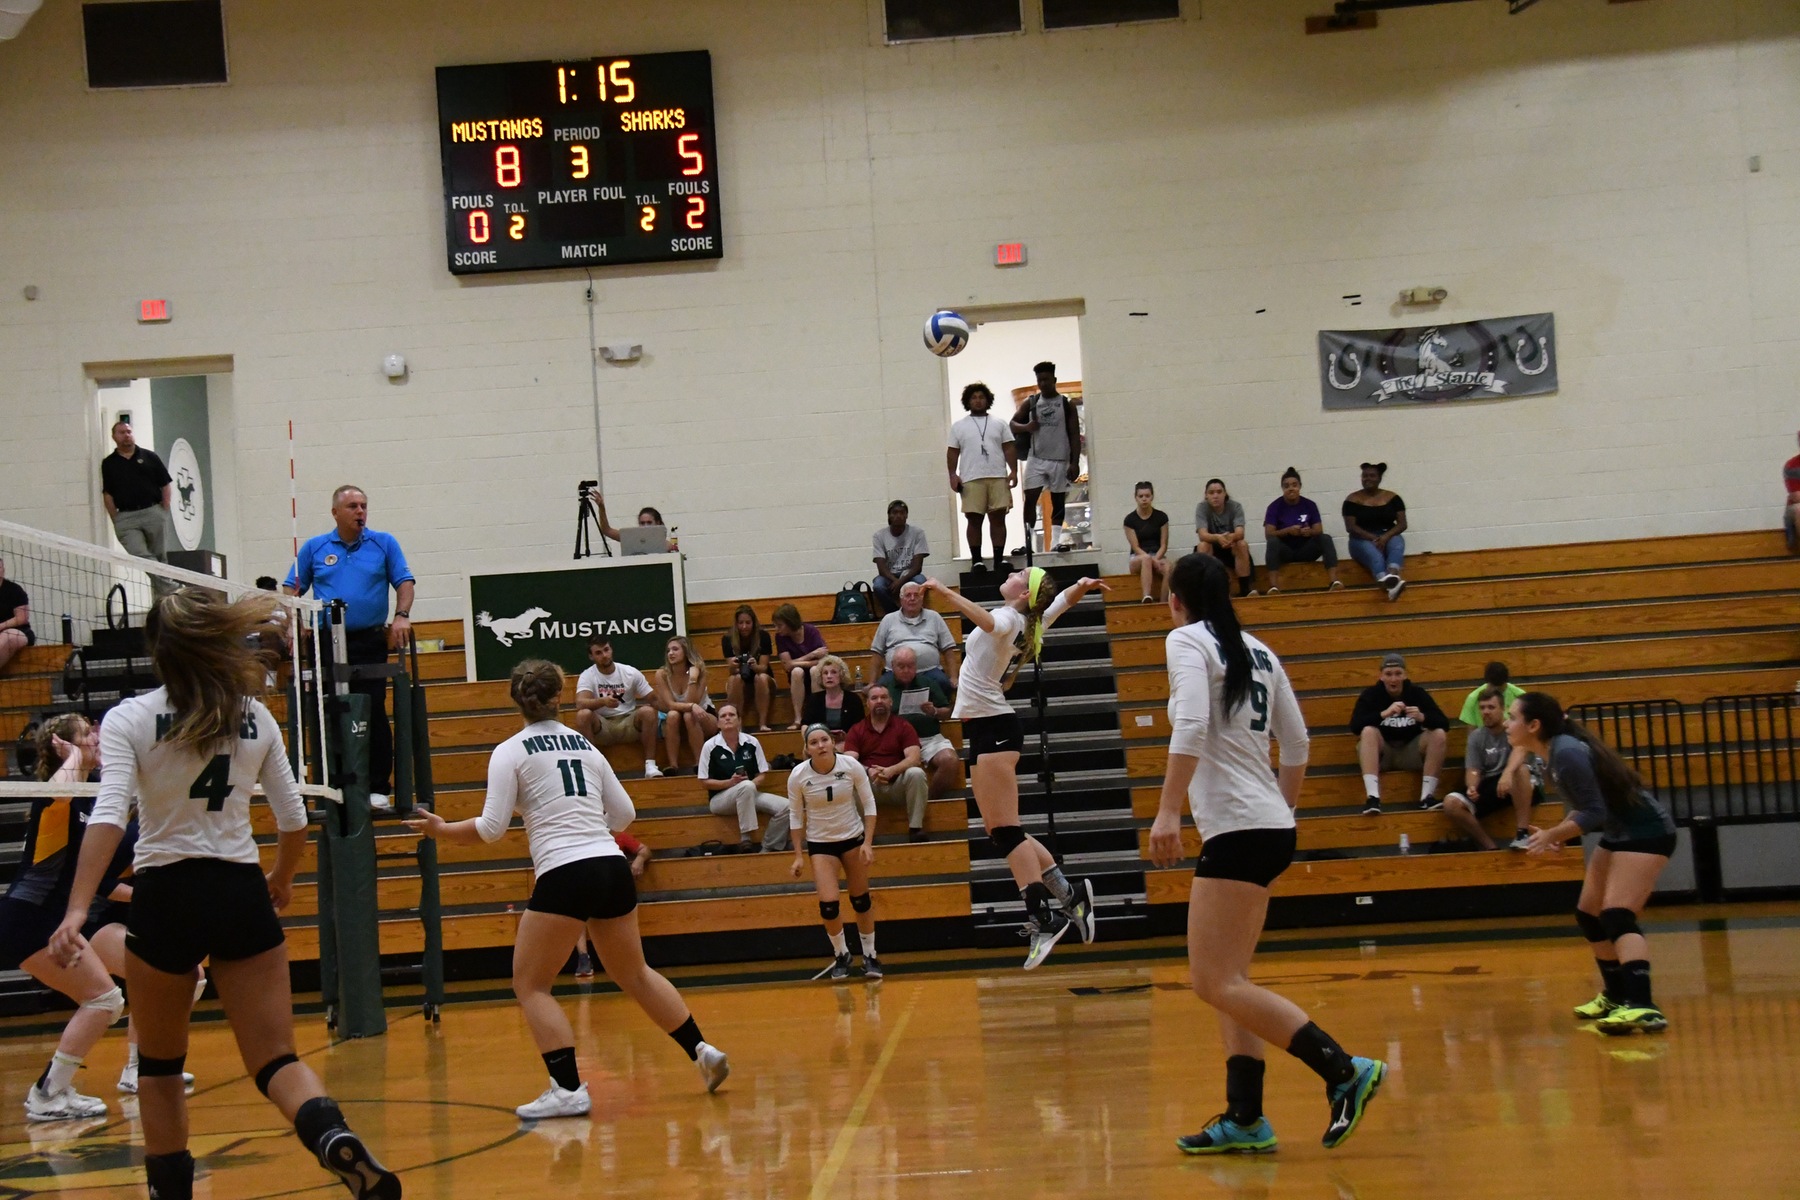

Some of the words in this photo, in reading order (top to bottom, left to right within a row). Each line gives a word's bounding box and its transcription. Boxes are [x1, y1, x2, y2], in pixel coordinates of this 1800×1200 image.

[452, 117, 543, 143] MUSTANGS
[620, 108, 685, 132] SHARKS
[554, 126, 600, 141] PERIOD
[570, 145, 589, 179] 3
[678, 133, 703, 176] 5
[495, 146, 521, 187] 8
[538, 188, 588, 204] PLAYER
[593, 186, 627, 201] FOUL
[668, 180, 710, 196] FOULS
[452, 194, 494, 209] FOULS
[503, 203, 530, 213] T.O.L.
[635, 194, 661, 206] T.O.L.
[640, 206, 656, 231] 2
[686, 197, 705, 230] 2
[469, 211, 490, 243] 0
[509, 215, 525, 240] 2
[561, 243, 607, 259] MATCH
[671, 236, 713, 252] SCORE
[997, 243, 1023, 264] EXIT
[455, 250, 498, 266] SCORE
[141, 299, 167, 320] EXIT
[1436, 371, 1488, 386] Stable
[540, 613, 674, 639] MUSTANGS
[1249, 680, 1267, 732] 9
[189, 754, 235, 811] 4
[557, 759, 588, 796] 11
[825, 786, 833, 801] 1
